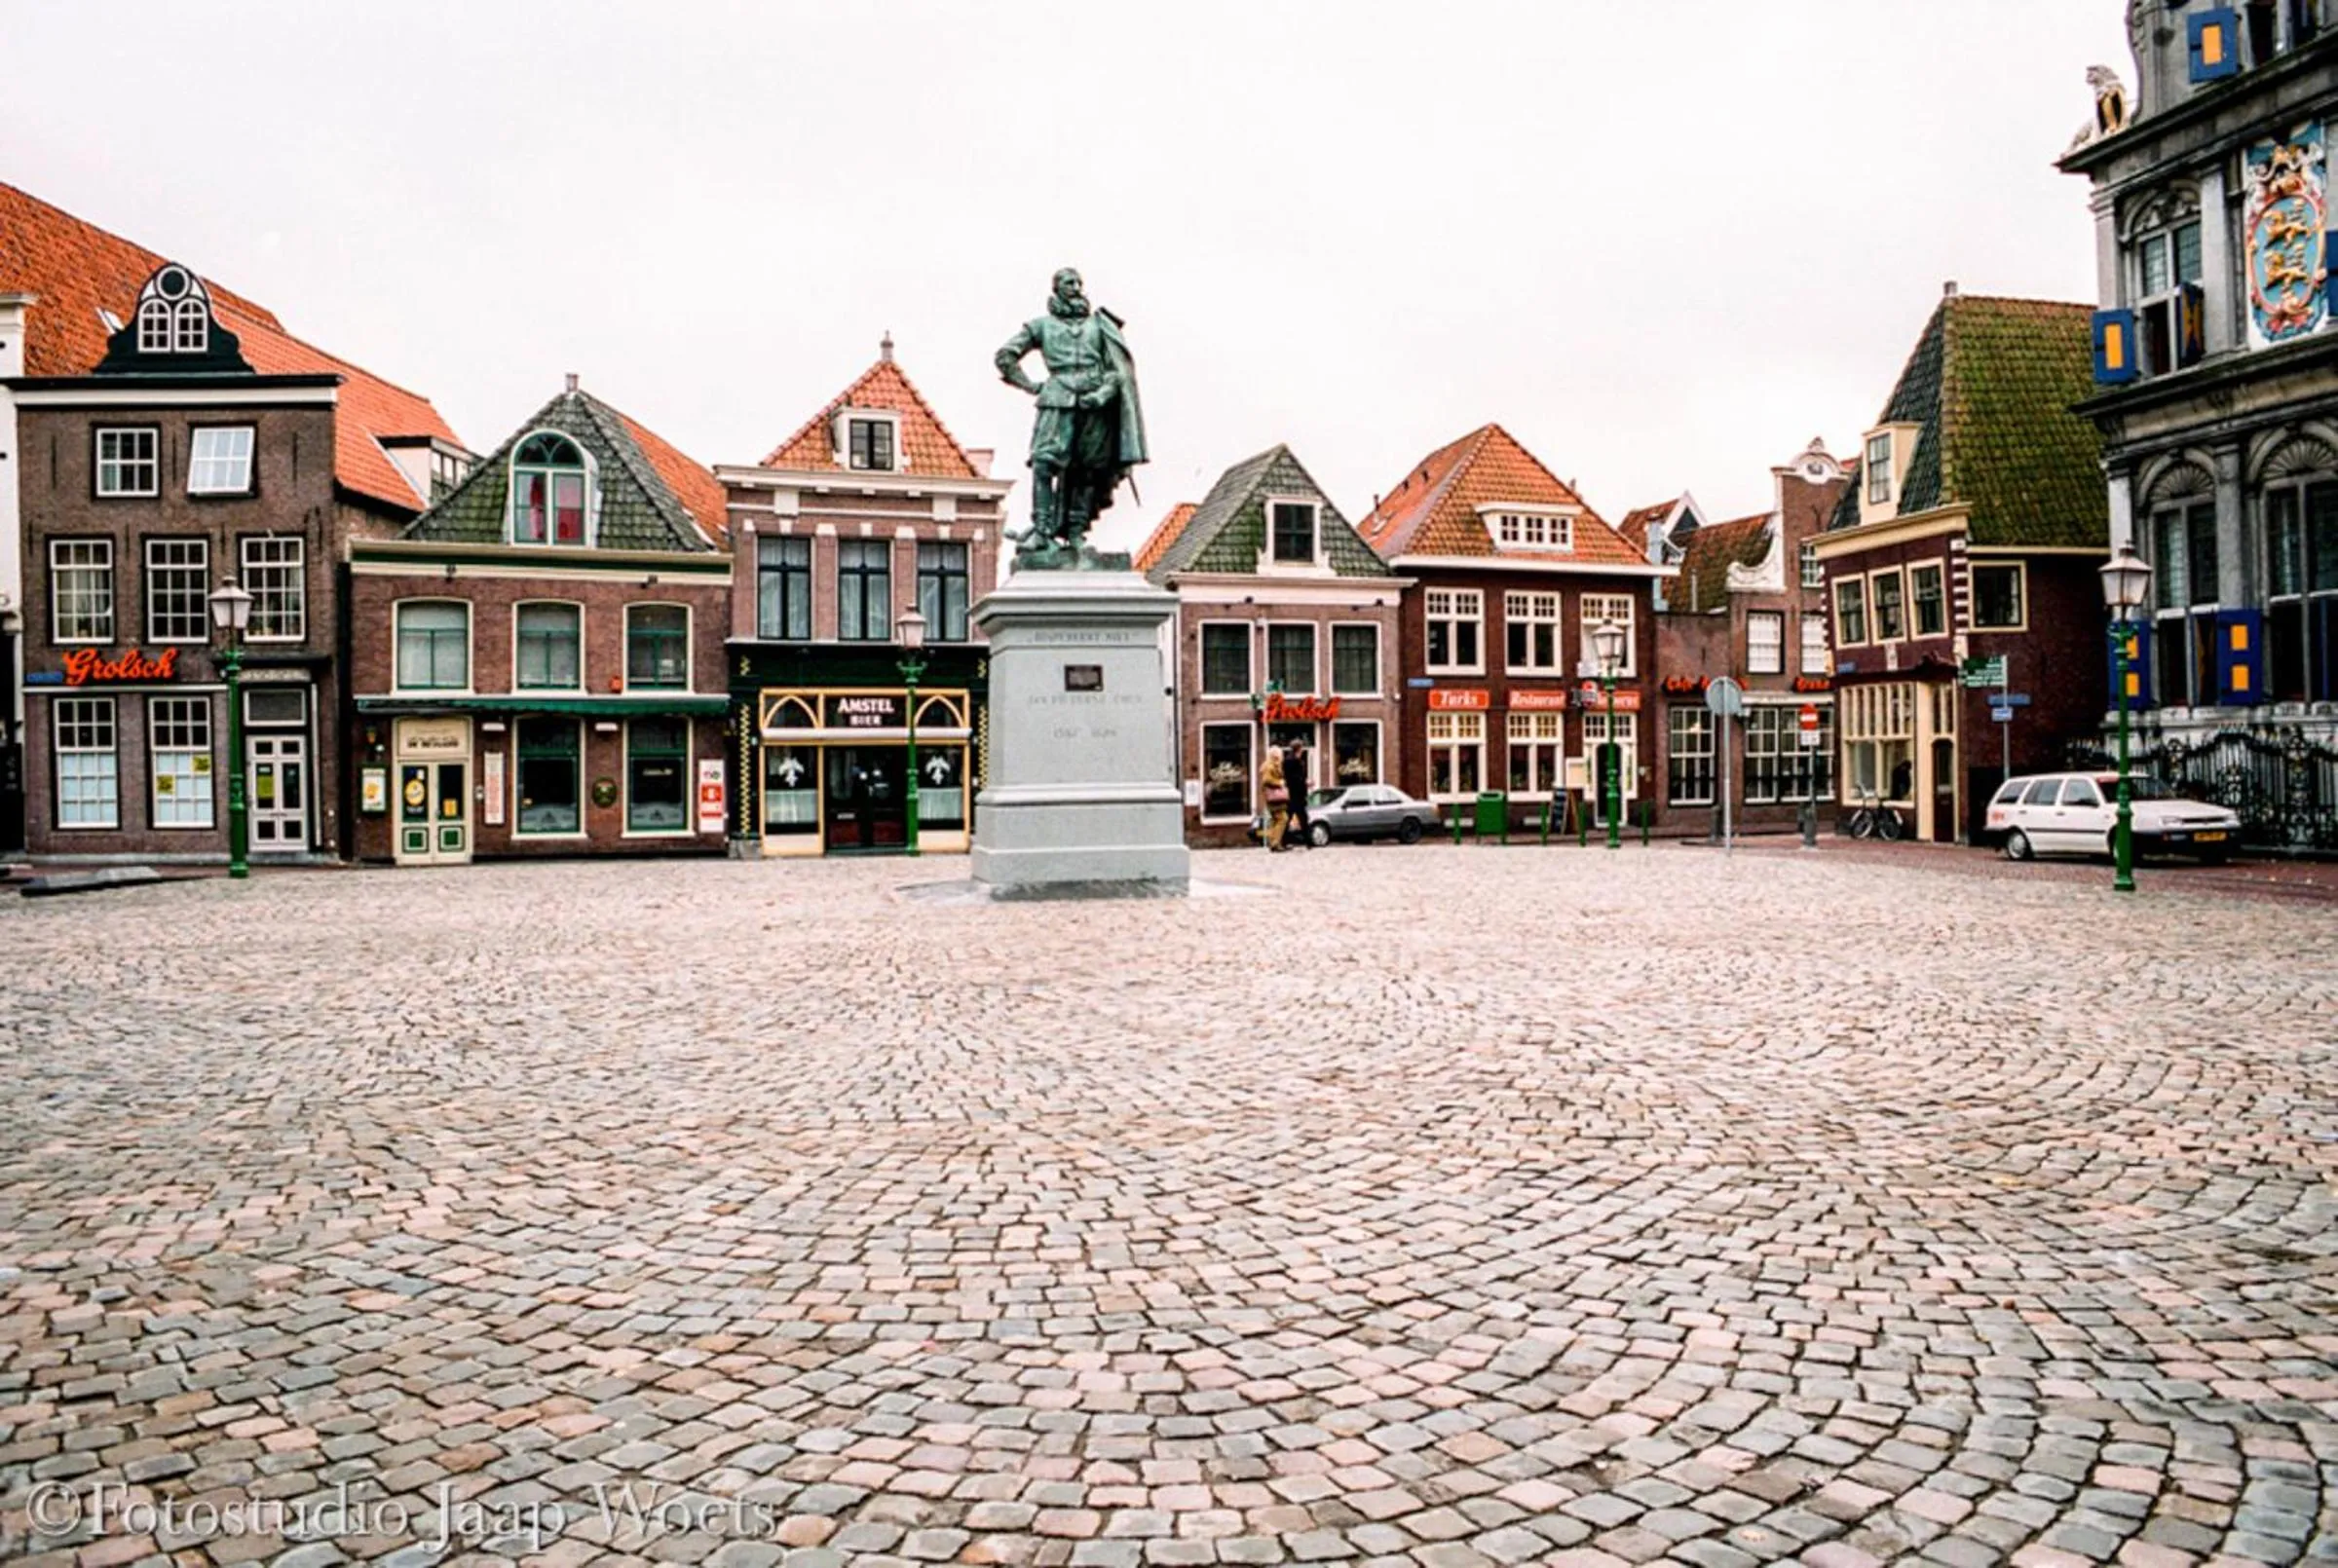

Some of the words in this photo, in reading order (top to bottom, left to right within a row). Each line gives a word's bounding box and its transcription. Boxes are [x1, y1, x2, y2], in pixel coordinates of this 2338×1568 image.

[62, 647, 177, 688] Grolsch
[837, 697, 895, 714] AMSTEL
[1440, 690, 1479, 707] Turks
[849, 715, 882, 727] BIER
